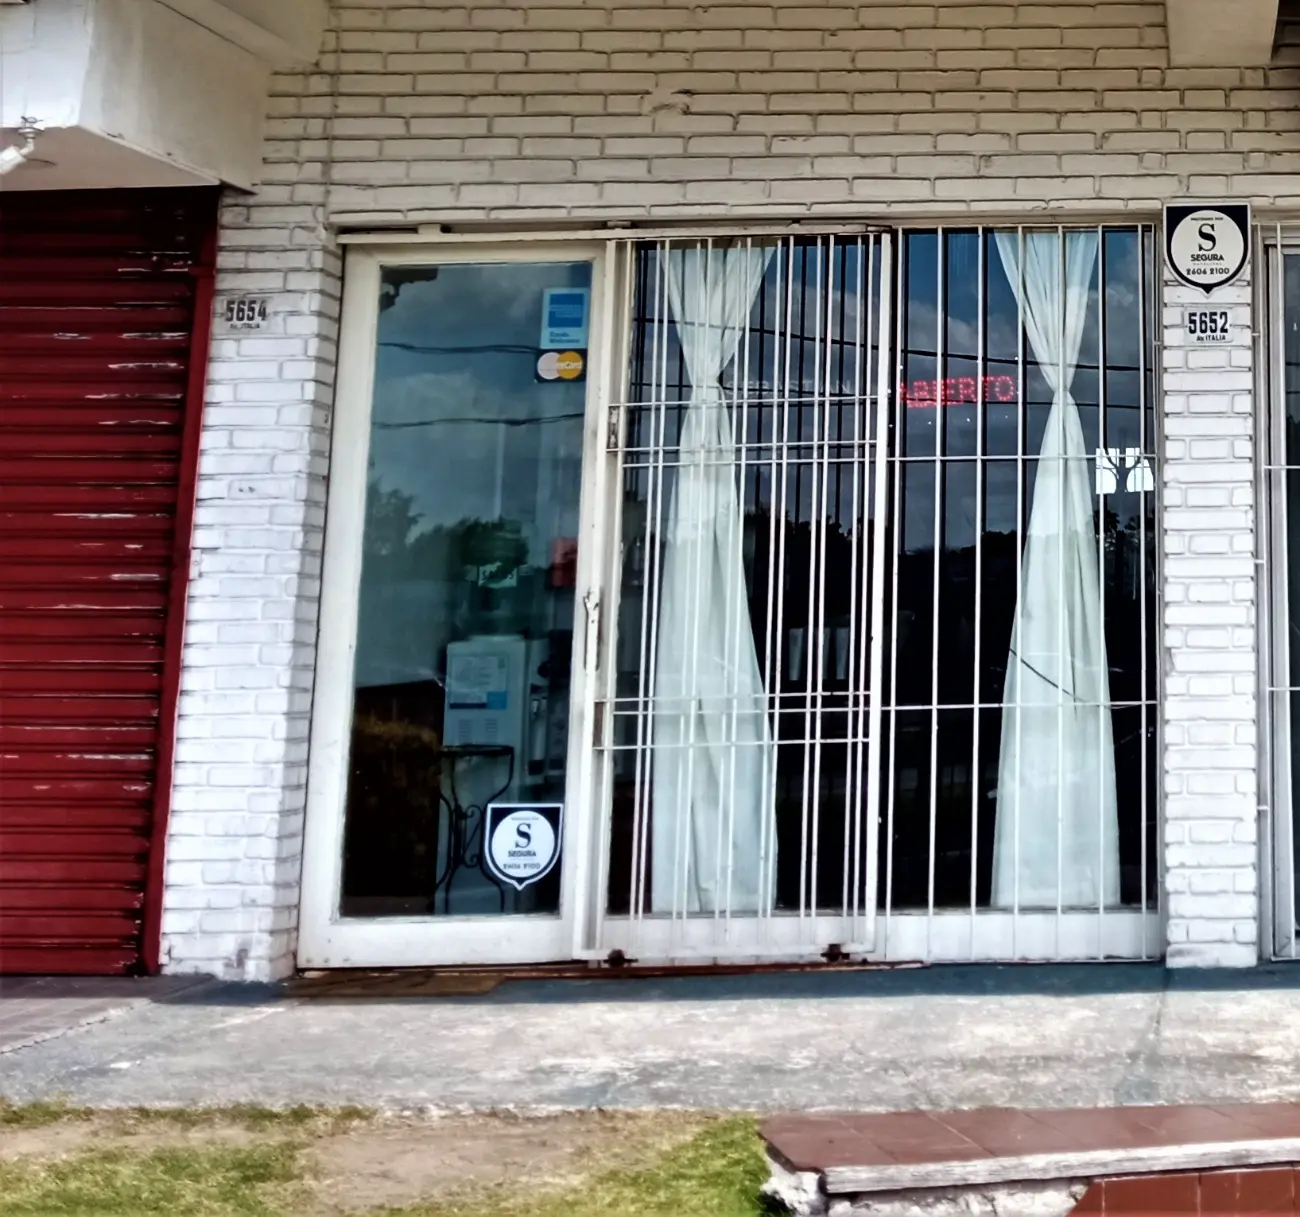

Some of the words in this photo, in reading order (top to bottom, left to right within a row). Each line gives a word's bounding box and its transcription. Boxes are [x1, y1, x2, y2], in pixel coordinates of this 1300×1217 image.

[1198, 222, 1216, 252] S
[1190, 253, 1225, 262] SEGURA
[225, 299, 267, 322] 5654
[1188, 311, 1229, 334] 5652
